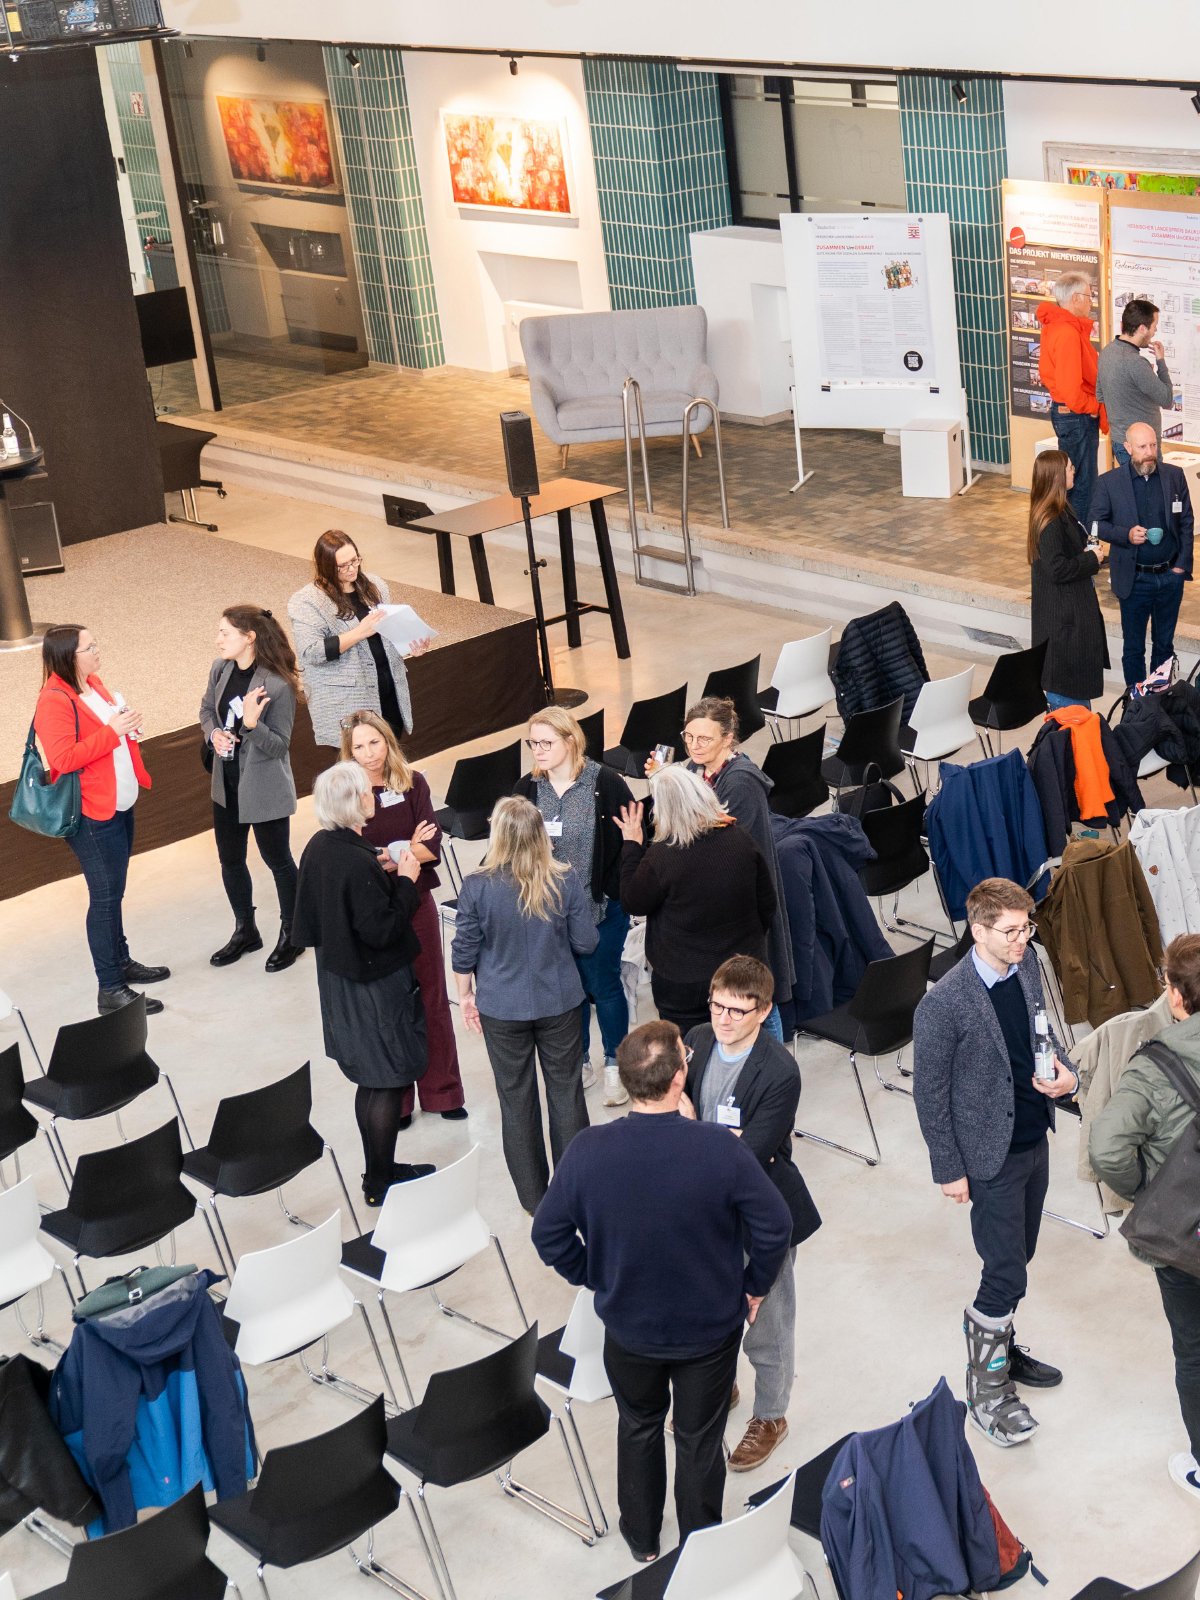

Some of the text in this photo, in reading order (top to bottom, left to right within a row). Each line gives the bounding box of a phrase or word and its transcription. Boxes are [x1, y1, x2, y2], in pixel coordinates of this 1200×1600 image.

[1009, 247, 1098, 264] DAS PROJEKT NIEMEYERHAUS
